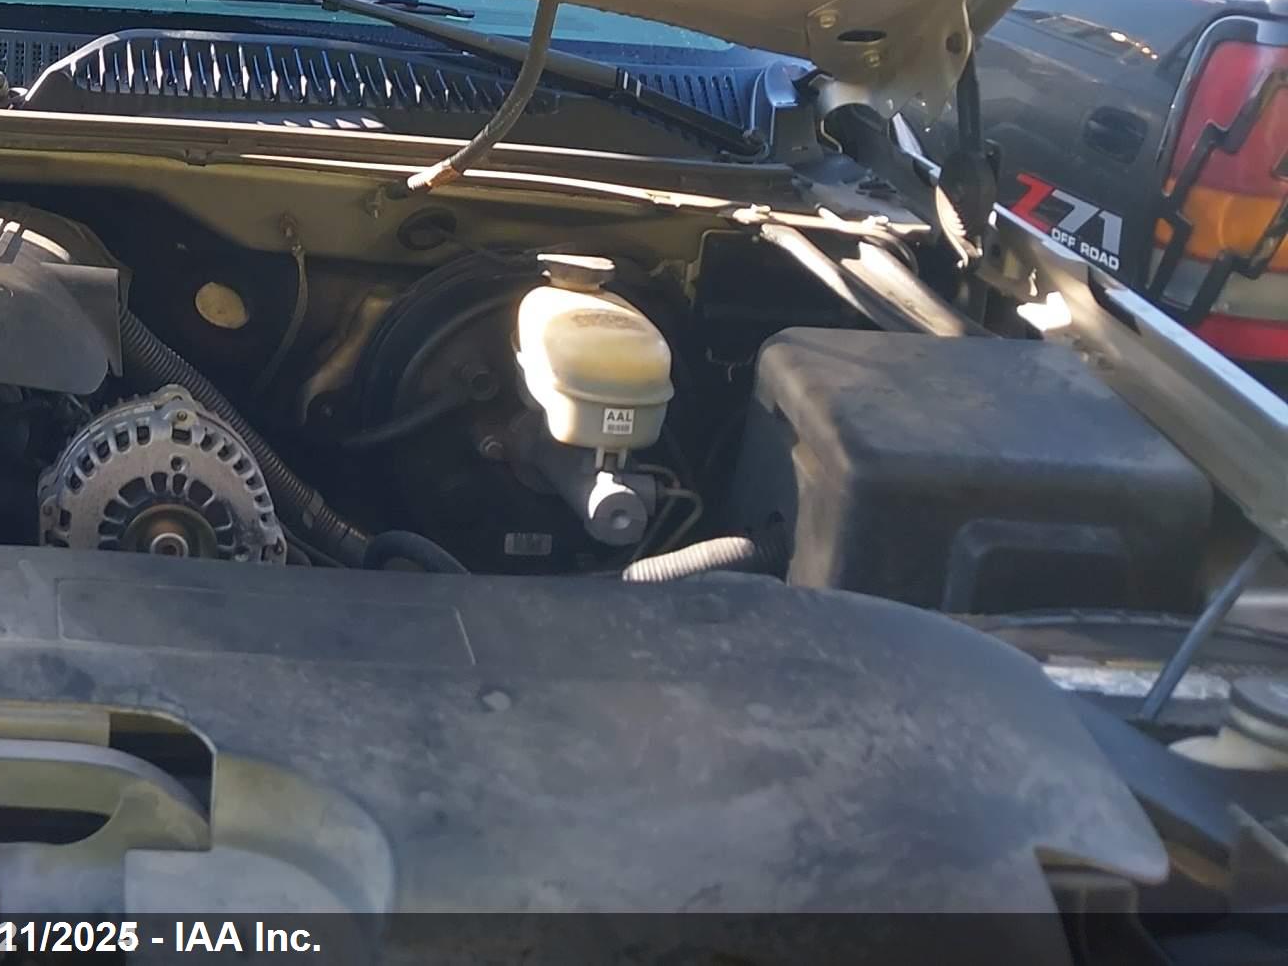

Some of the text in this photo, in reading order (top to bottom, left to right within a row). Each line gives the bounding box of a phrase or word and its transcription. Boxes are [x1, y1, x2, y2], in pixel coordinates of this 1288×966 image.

[1010, 172, 1123, 256] Z71
[1051, 226, 1120, 271] OFF ROAD
[606, 410, 632, 422] AAL
